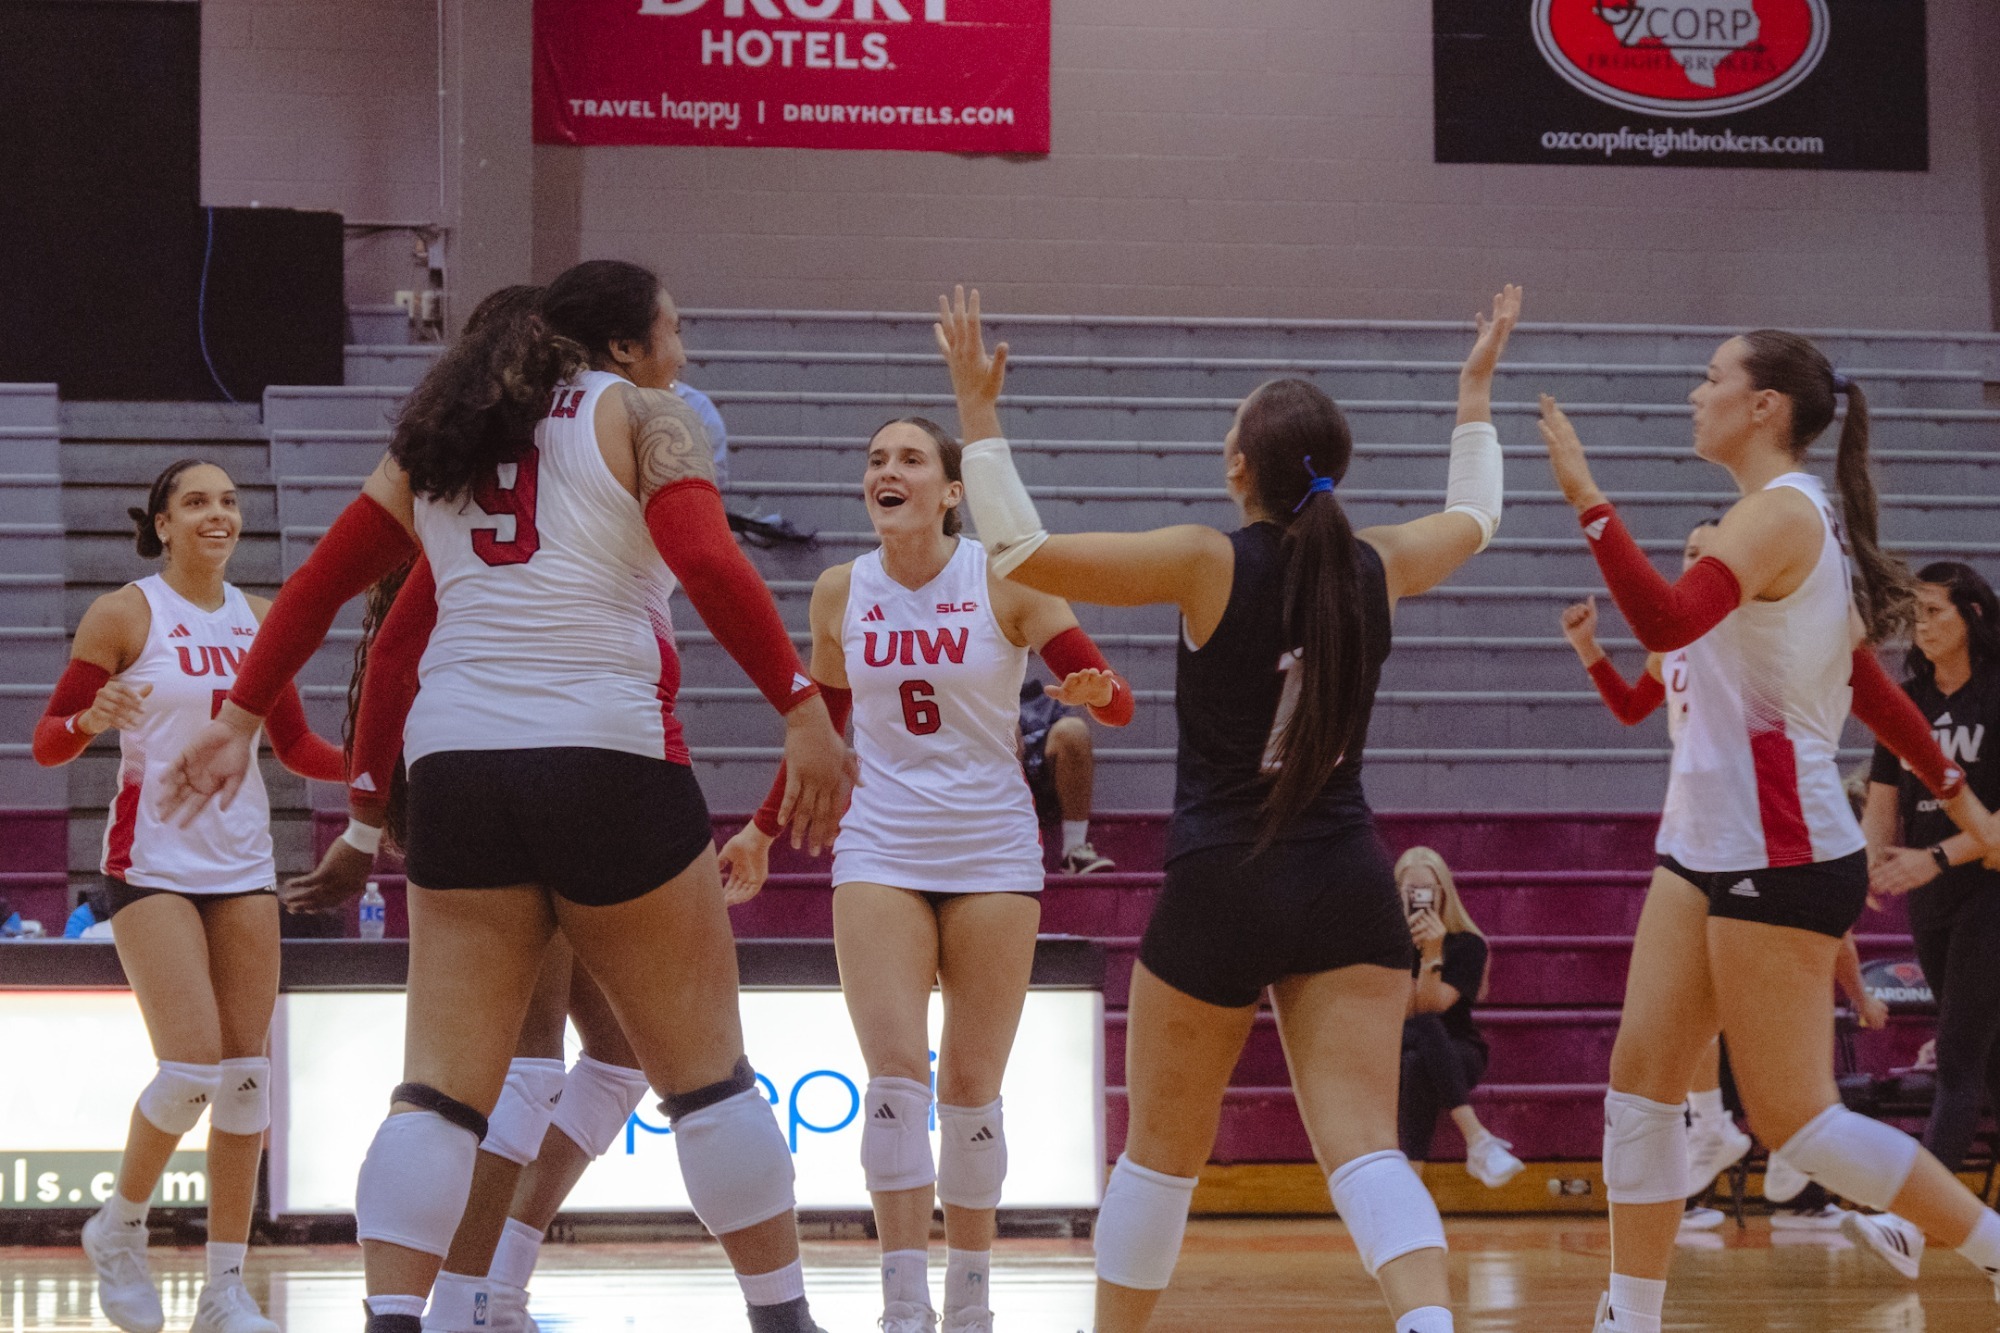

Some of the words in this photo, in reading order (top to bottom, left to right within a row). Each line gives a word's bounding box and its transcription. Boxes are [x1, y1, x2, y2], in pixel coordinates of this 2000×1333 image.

[569, 99, 655, 118] TRAVEL
[661, 93, 741, 130] happy
[783, 105, 1014, 126] DRURYHOTELS.COM
[1541, 127, 1824, 158] ozcorpfreightbrokers.com
[471, 446, 540, 567] 9
[936, 602, 974, 613] SLC
[863, 627, 970, 667] UIW
[899, 680, 941, 735] 6
[0, 1158, 206, 1202] ls.cm
